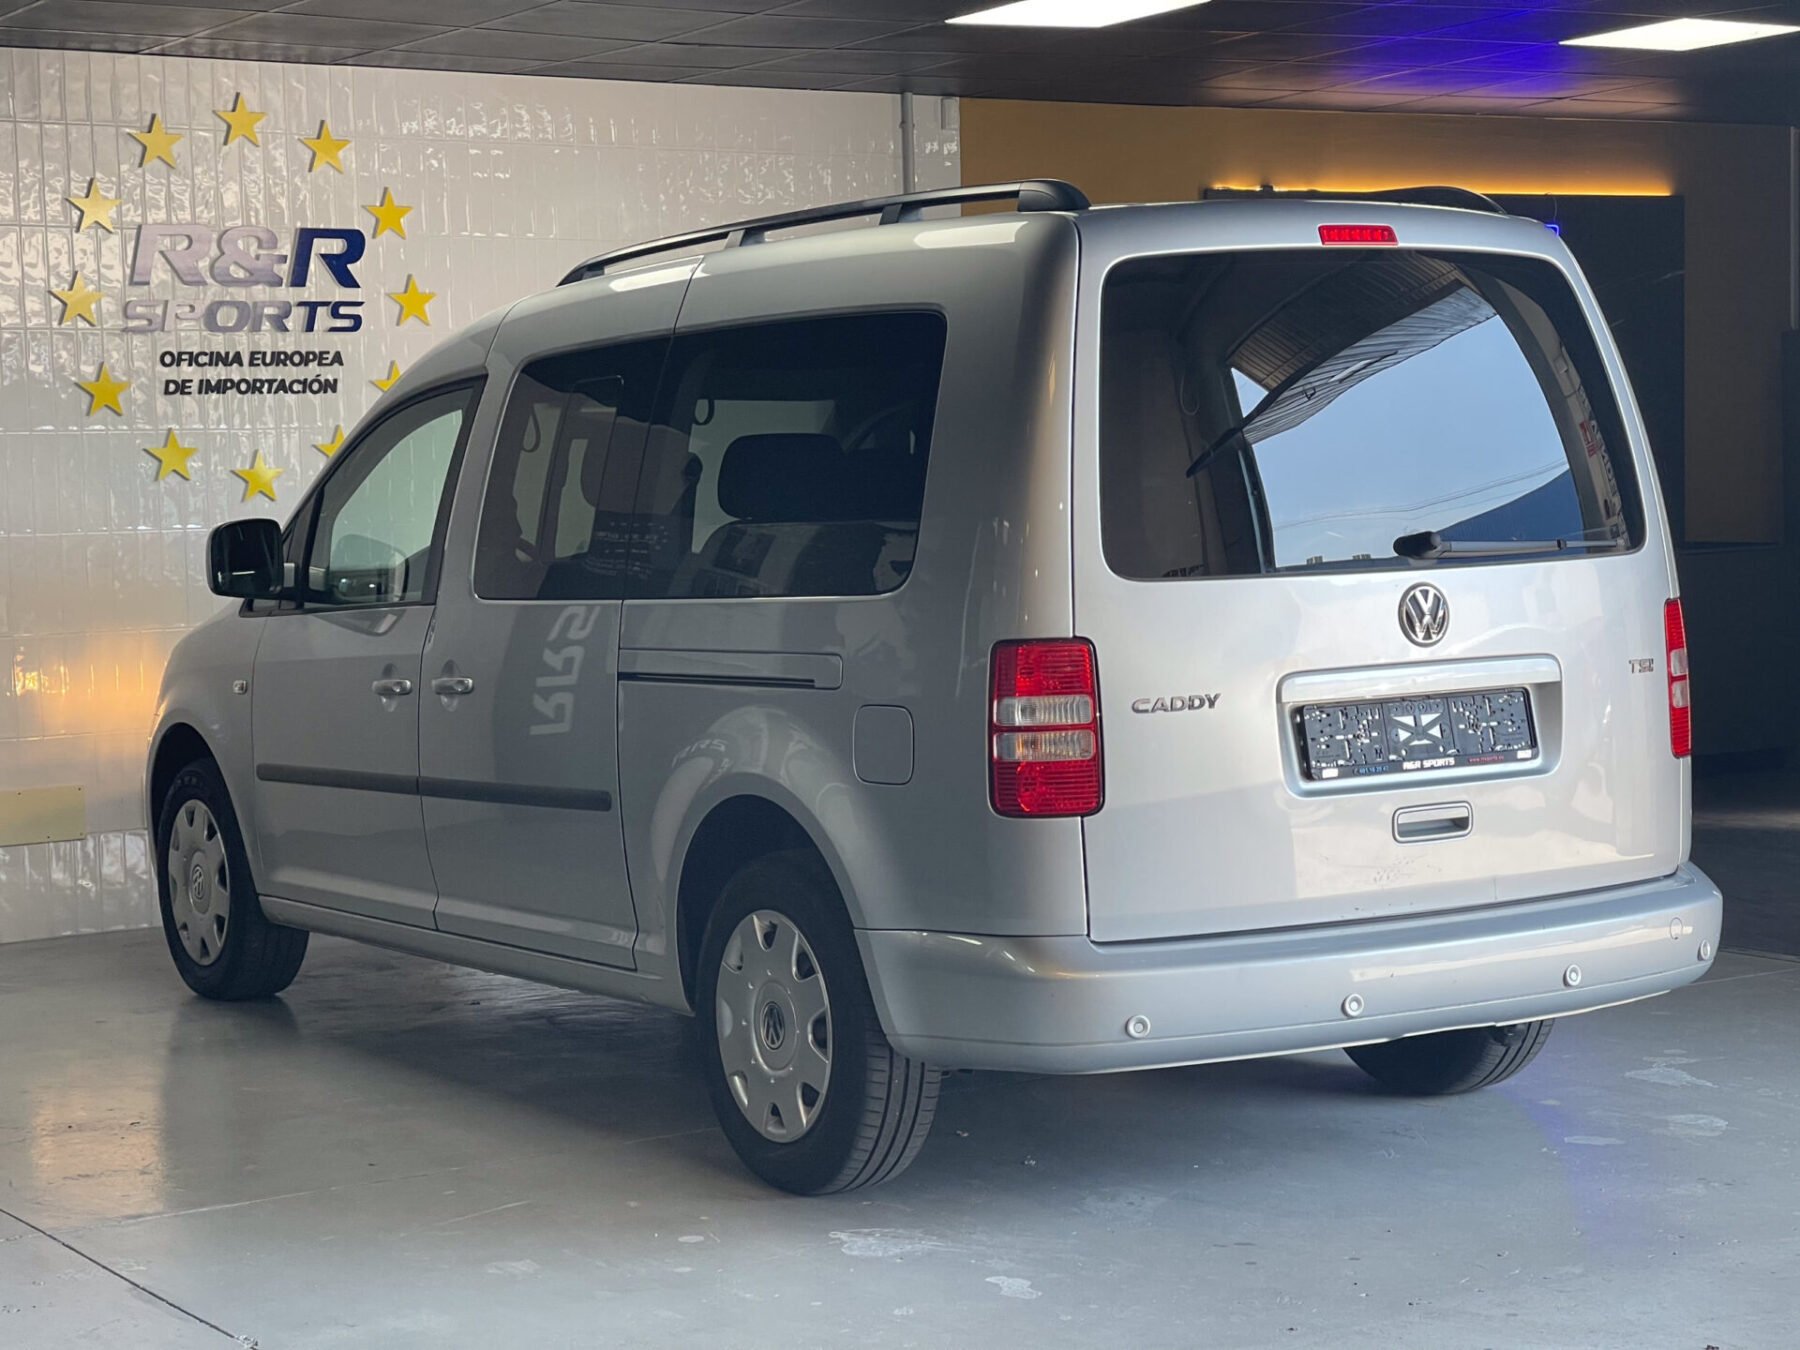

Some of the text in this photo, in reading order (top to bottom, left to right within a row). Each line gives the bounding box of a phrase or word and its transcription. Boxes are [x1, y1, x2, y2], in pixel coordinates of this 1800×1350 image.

[128, 224, 366, 289] R&R
[120, 299, 366, 334] SPORTS
[159, 350, 344, 368] OFICINA EUROPEA
[164, 373, 338, 396] DE IMPORTACIÓN
[1131, 692, 1222, 714] CADDY
[1422, 757, 1456, 769] SPORTS
